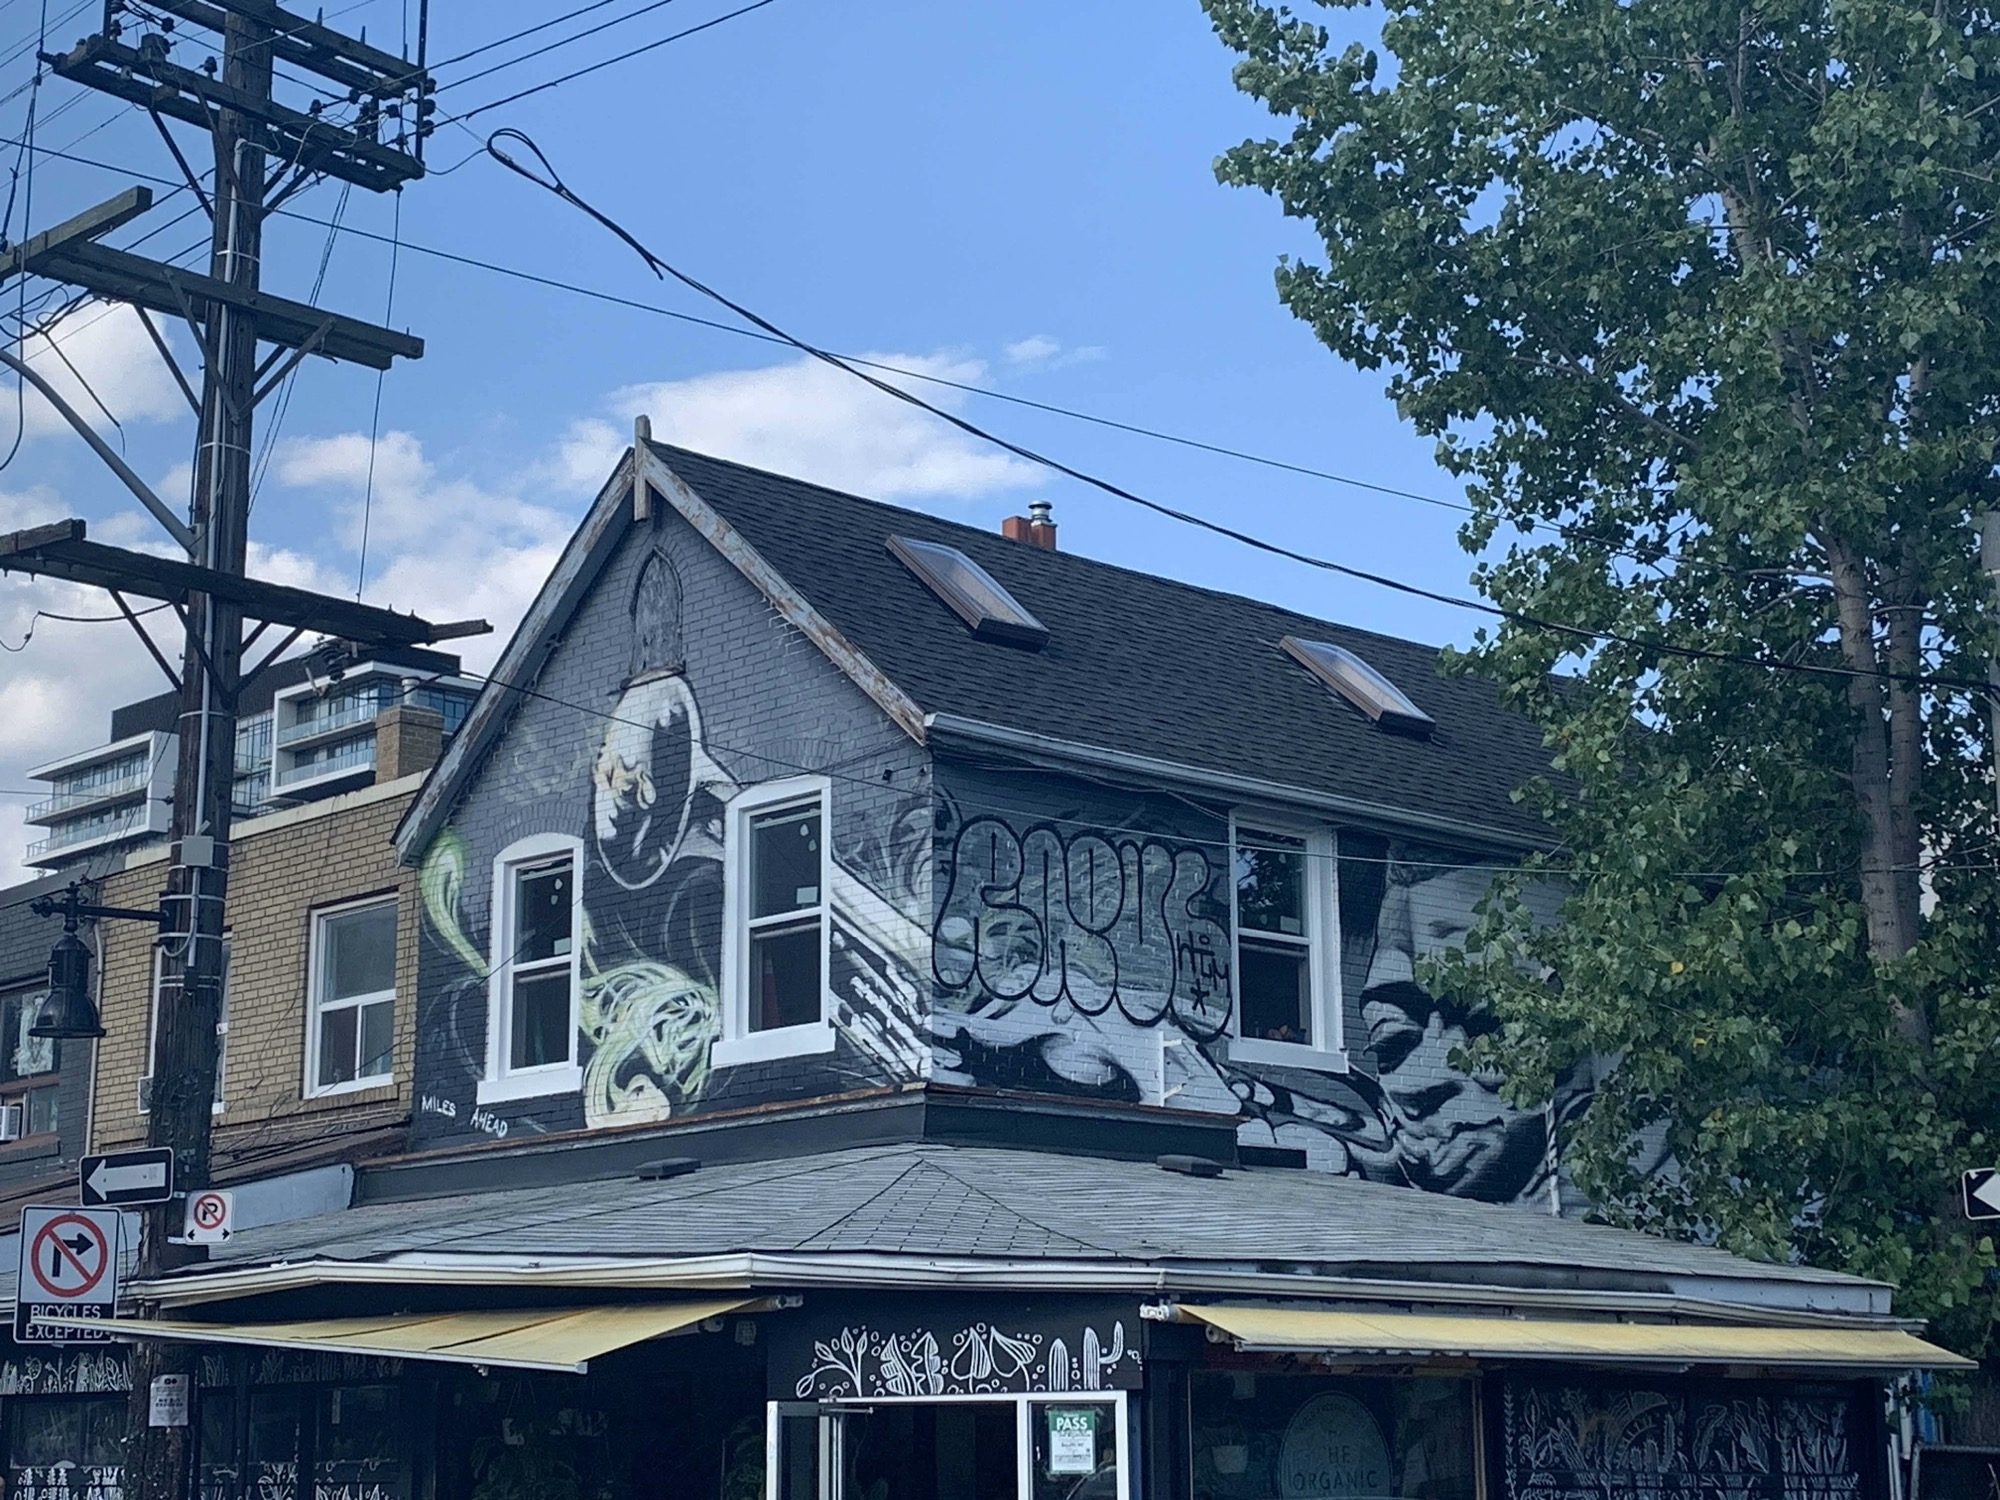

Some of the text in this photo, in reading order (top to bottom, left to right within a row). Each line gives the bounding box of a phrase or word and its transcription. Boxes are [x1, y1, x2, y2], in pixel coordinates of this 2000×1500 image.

[421, 1095, 508, 1138] MILES AHEAD
[31, 1304, 100, 1320] BICYCLES
[1056, 1416, 1088, 1431] PASS
[1293, 1469, 1377, 1490] ORGANIC
